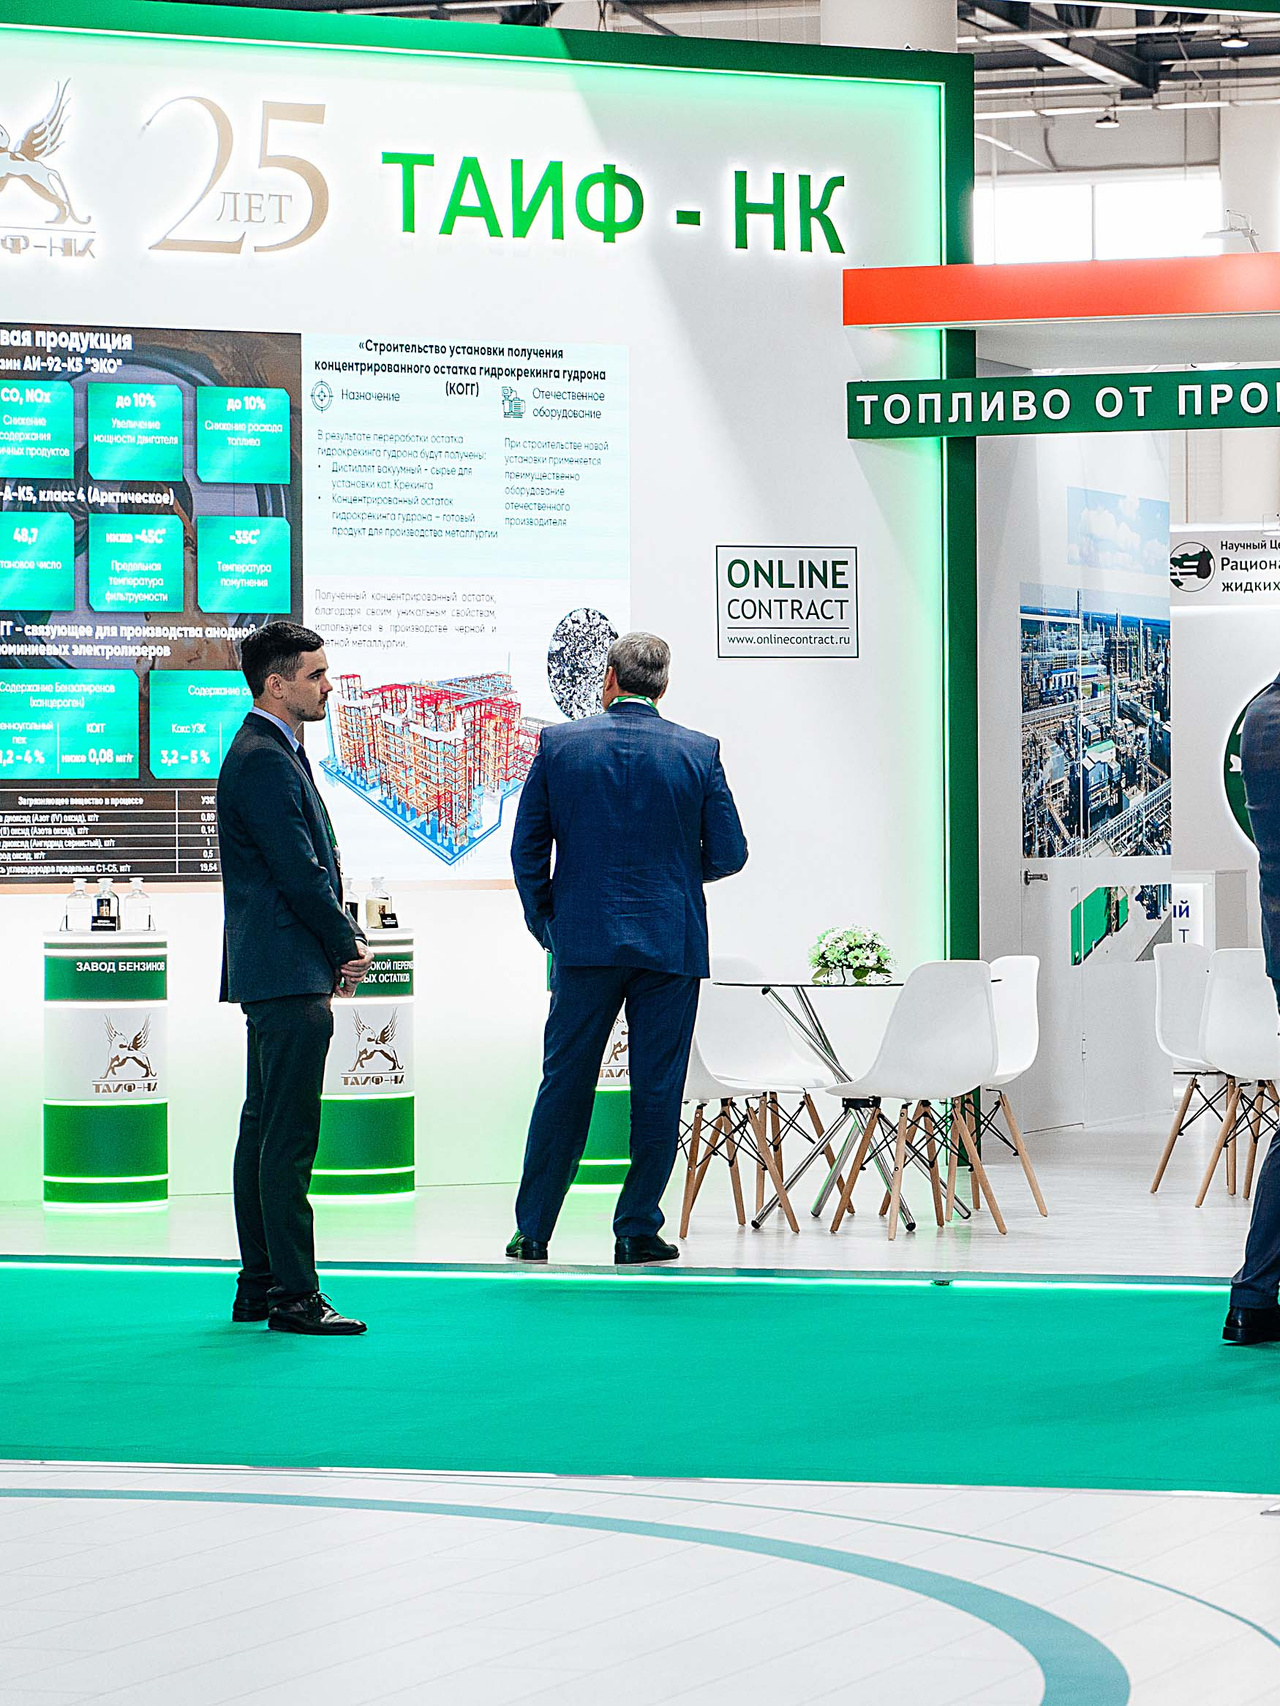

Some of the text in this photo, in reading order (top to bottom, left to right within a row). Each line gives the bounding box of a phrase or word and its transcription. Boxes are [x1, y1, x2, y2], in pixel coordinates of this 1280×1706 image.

[138, 96, 329, 254] 25
[214, 190, 293, 226] ЛЕТ
[380, 152, 645, 243] ТАИФ
[733, 169, 846, 256] НК
[35, 331, 133, 353] продукция
[359, 340, 564, 360] «Строительство установки получения
[23, 356, 123, 373] АИ-92-К5 "ЭКО"
[314, 360, 606, 383] концентрированного остатка гидрокрекинга гудрона
[341, 389, 400, 402] Назначение
[445, 381, 480, 397] (КОГГ)
[532, 387, 605, 402] Отечественное
[115, 393, 157, 408] до 10%
[226, 395, 266, 412] до 10%
[856, 388, 1071, 427] ТОПЛИВО
[1094, 385, 1152, 421] ОТ
[532, 407, 602, 420] оборудование
[325, 431, 371, 443] результате
[373, 432, 428, 444] переработки
[431, 434, 464, 444] остатка
[504, 437, 609, 451] При строительстве новой
[383, 449, 418, 459] гудрона
[420, 449, 443, 460] будут
[504, 454, 547, 466] установки
[332, 462, 473, 476] Дистиллят вакуумный сырье для
[332, 480, 375, 490] установки
[39, 485, 175, 507] класс 4 (Арктическое)
[421, 496, 453, 506] остаток
[504, 501, 571, 512] отечественного
[504, 516, 567, 527] производителя
[13, 528, 38, 545] 48,7
[332, 526, 498, 540] продукт для производства металлургии
[1220, 540, 1267, 551] Научный
[727, 559, 849, 589] ONLINE
[1221, 578, 1280, 593] жидких
[727, 599, 849, 620] CONTRACT
[24, 624, 93, 640] связующее
[95, 625, 118, 640] для
[119, 625, 203, 641] производства
[727, 634, 850, 645] www.onlinecontract.ru
[72, 645, 171, 660] электролизеров
[88, 748, 114, 765] 0,08
[160, 749, 179, 766] 3,2
[76, 961, 165, 973] ЗАВОД БЕНЗИНОВ
[379, 973, 410, 983] ОСТАТКОВ
